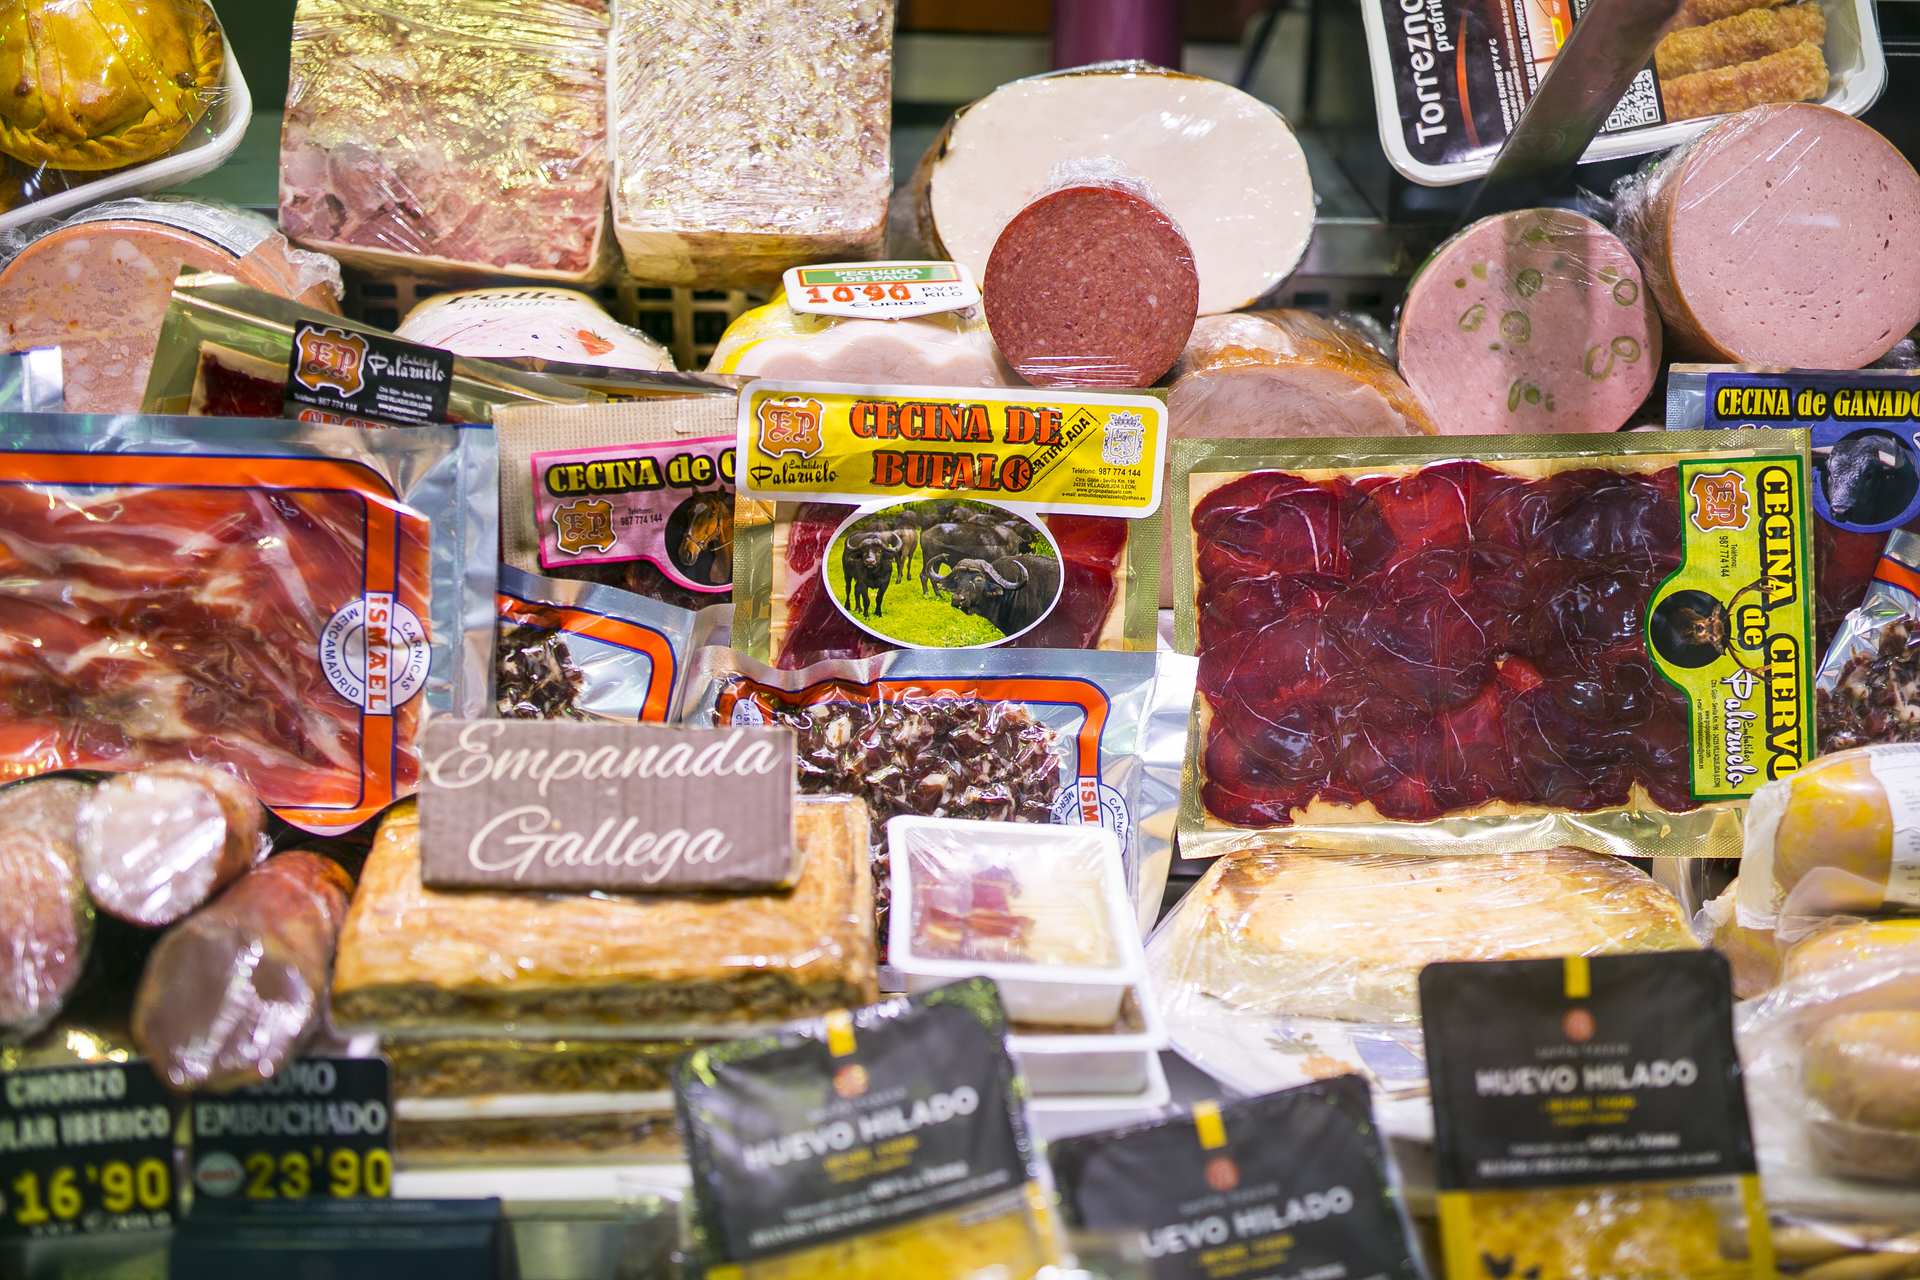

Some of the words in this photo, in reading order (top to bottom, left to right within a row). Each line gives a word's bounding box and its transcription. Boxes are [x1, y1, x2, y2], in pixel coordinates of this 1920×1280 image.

[1520, 38, 1534, 63] BUEN
[1525, 63, 1536, 77] UN
[1494, 71, 1508, 98] ENTRE
[834, 268, 923, 278] PECHUGA
[842, 275, 869, 283] DE
[871, 274, 919, 282] PAVO
[850, 400, 994, 444] CECINA
[1003, 405, 1063, 446] DE
[1716, 387, 1792, 417] CECINA
[1796, 388, 1828, 418] de
[788, 459, 824, 470] Embutidos
[1021, 416, 1091, 481] CERTIFICADA
[547, 458, 661, 494] CECINA
[668, 455, 713, 485] de
[749, 460, 840, 489] Palazuelo
[870, 449, 1033, 493] BUFALO
[1071, 467, 1098, 476] Teléfono:
[1098, 467, 1111, 476] 987
[1113, 468, 1126, 477] 774
[1128, 469, 1141, 478] 144
[620, 515, 633, 526] 987
[634, 514, 648, 525] 774
[649, 512, 663, 524] 144
[627, 507, 654, 516] Teléfono:
[1719, 535, 1729, 550] 987
[1719, 550, 1730, 564] 774
[1730, 543, 1738, 569] Teléfono:
[1760, 468, 1795, 606] CECINA
[1720, 564, 1731, 578] 144
[1742, 606, 1767, 647] de
[325, 608, 359, 698] MERCAMADRID
[401, 621, 423, 691] CARNICAS
[1720, 668, 1759, 788] Palazuelo
[1768, 636, 1800, 780] CIERVO
[424, 719, 783, 797] Empanada
[1743, 720, 1755, 762] Embutidos
[1053, 790, 1075, 824] MERCA
[1081, 781, 1100, 823] iSM
[1109, 797, 1125, 840] CARNIC
[467, 804, 734, 884] Gallega
[5, 1067, 127, 1108] CHORIZO
[247, 1061, 338, 1096] OMO
[1474, 1064, 1579, 1098] HUEVO
[1581, 1057, 1699, 1092] HILADO
[60, 1105, 171, 1146] IBERICO
[742, 1120, 856, 1172] HUEVO
[857, 1085, 980, 1143] HILADO
[12, 1157, 171, 1225] 16'90
[245, 1147, 392, 1199] 23'90
[1138, 1215, 1231, 1259] UEVO
[1231, 1185, 1355, 1239] HILADO
